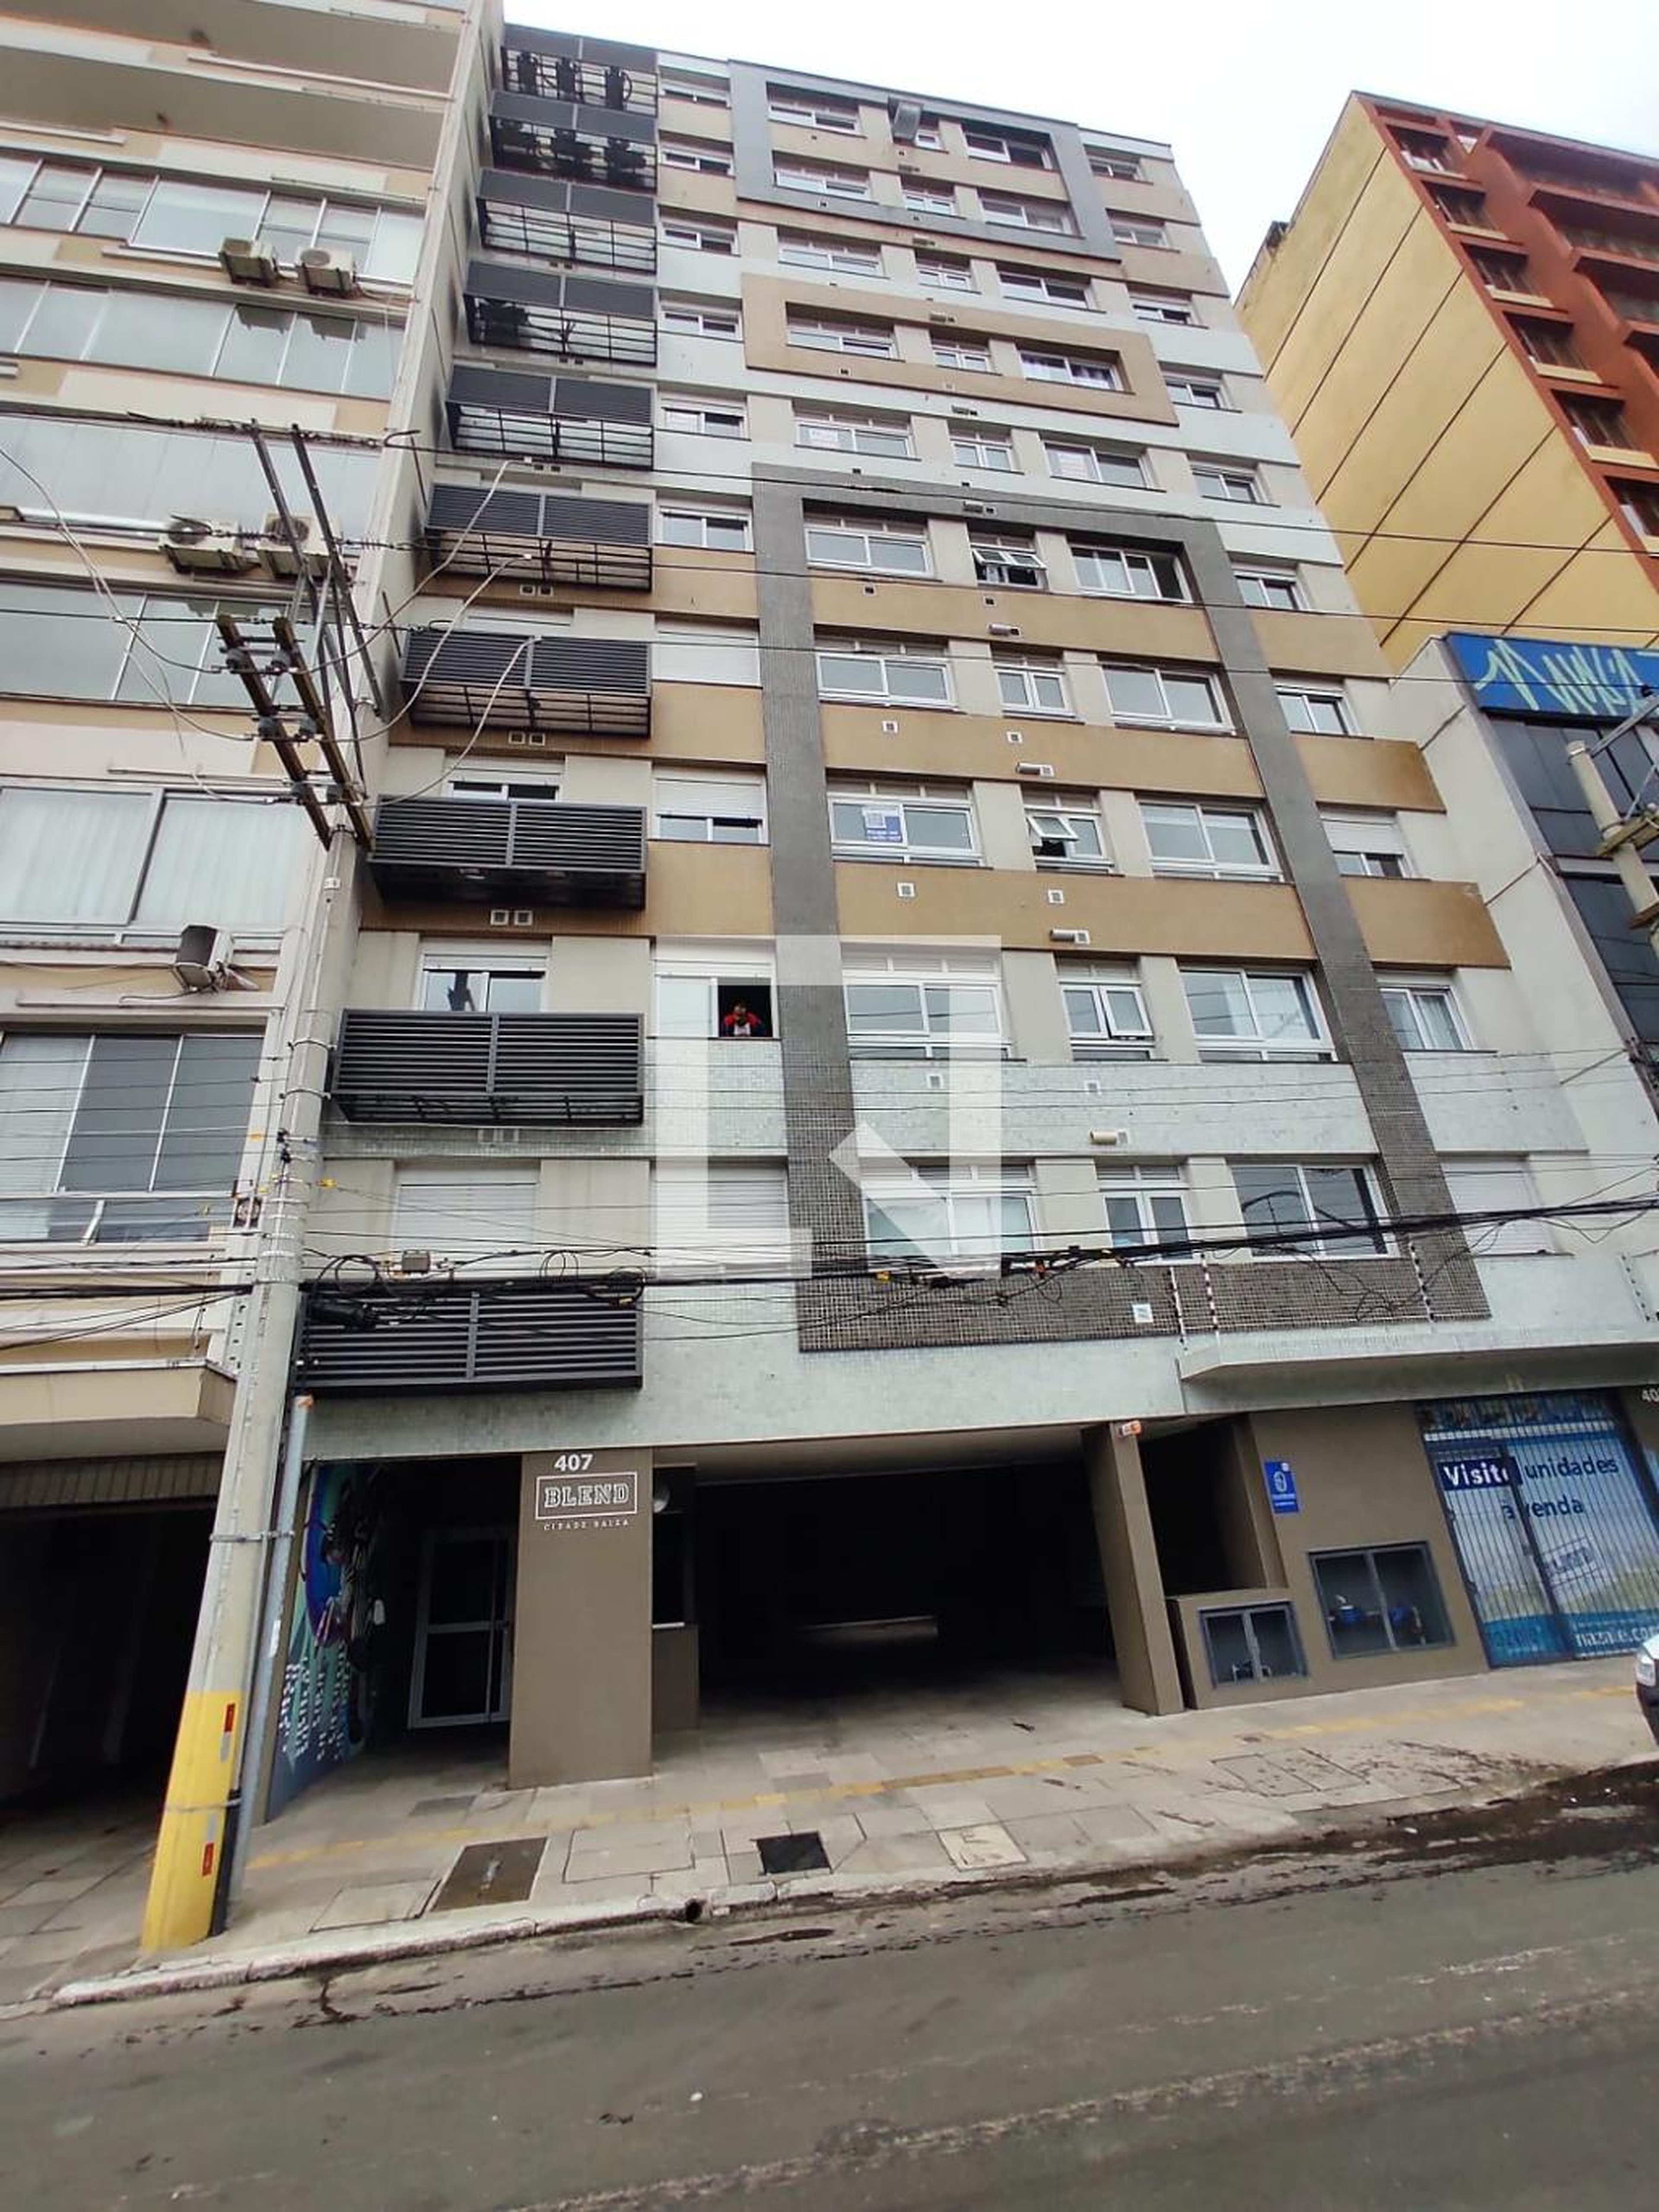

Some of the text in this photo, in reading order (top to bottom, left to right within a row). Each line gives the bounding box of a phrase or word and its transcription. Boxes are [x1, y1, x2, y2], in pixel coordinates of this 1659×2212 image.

[554, 1454, 593, 1471] 407
[1524, 1456, 1619, 1479] unidades
[544, 1483, 629, 1508] BLEND
